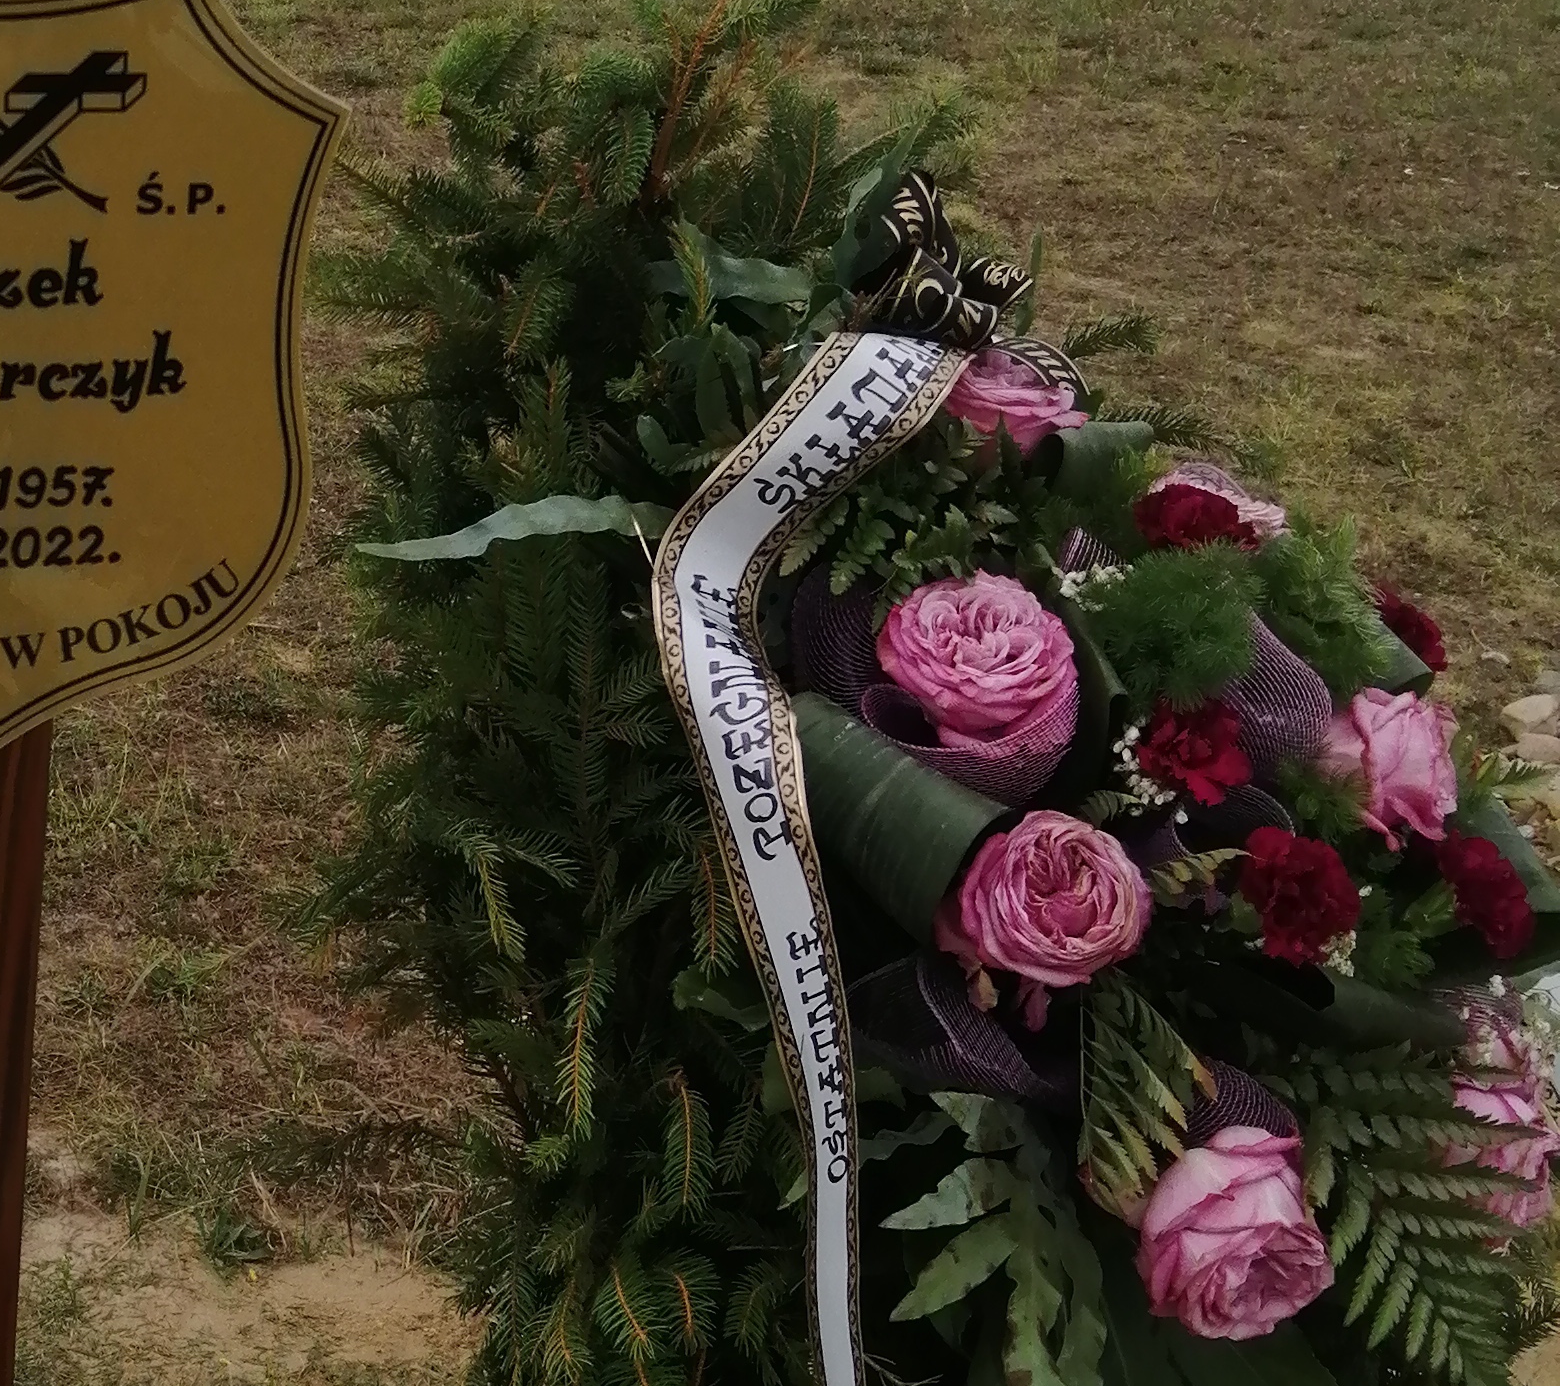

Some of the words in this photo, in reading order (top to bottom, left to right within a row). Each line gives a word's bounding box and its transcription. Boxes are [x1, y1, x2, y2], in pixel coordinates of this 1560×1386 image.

[0, 631, 45, 670] W
[57, 558, 241, 664] POKOJU
[785, 916, 849, 1185] OSTATNIE
